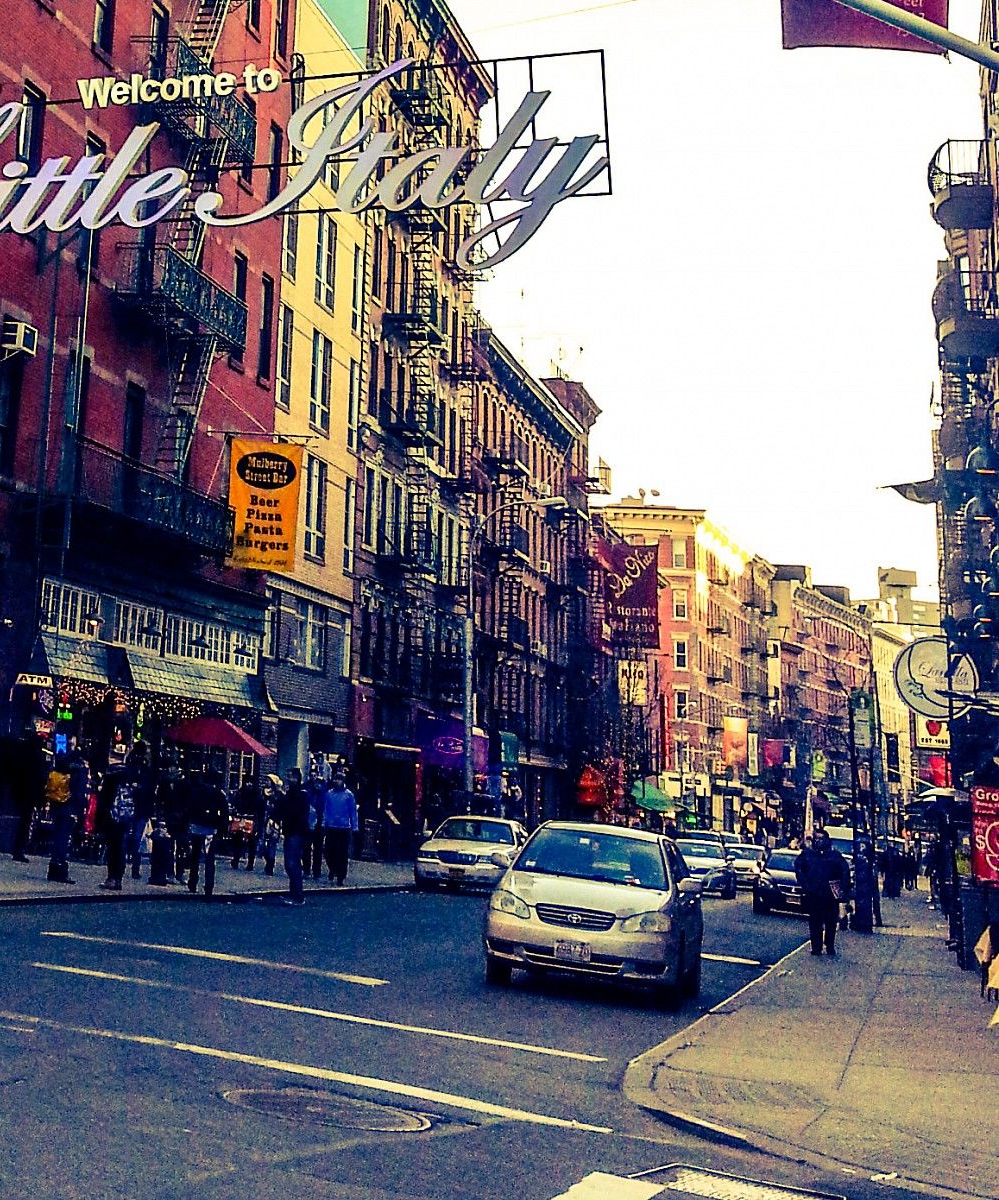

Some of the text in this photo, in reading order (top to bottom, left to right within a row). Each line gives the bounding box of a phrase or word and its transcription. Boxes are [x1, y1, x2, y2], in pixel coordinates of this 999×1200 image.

[77, 63, 282, 109] Welcome to
[195, 57, 610, 272] Italy
[247, 456, 288, 473] Mulberry
[244, 469, 288, 484] Street Bar
[249, 494, 280, 508] Beer
[246, 508, 283, 522] Pizza
[244, 522, 283, 536] Pasta
[236, 535, 289, 552] Burgers
[606, 549, 655, 598] Da Nico
[608, 601, 657, 617] Rstorante
[19, 674, 49, 685] ATM
